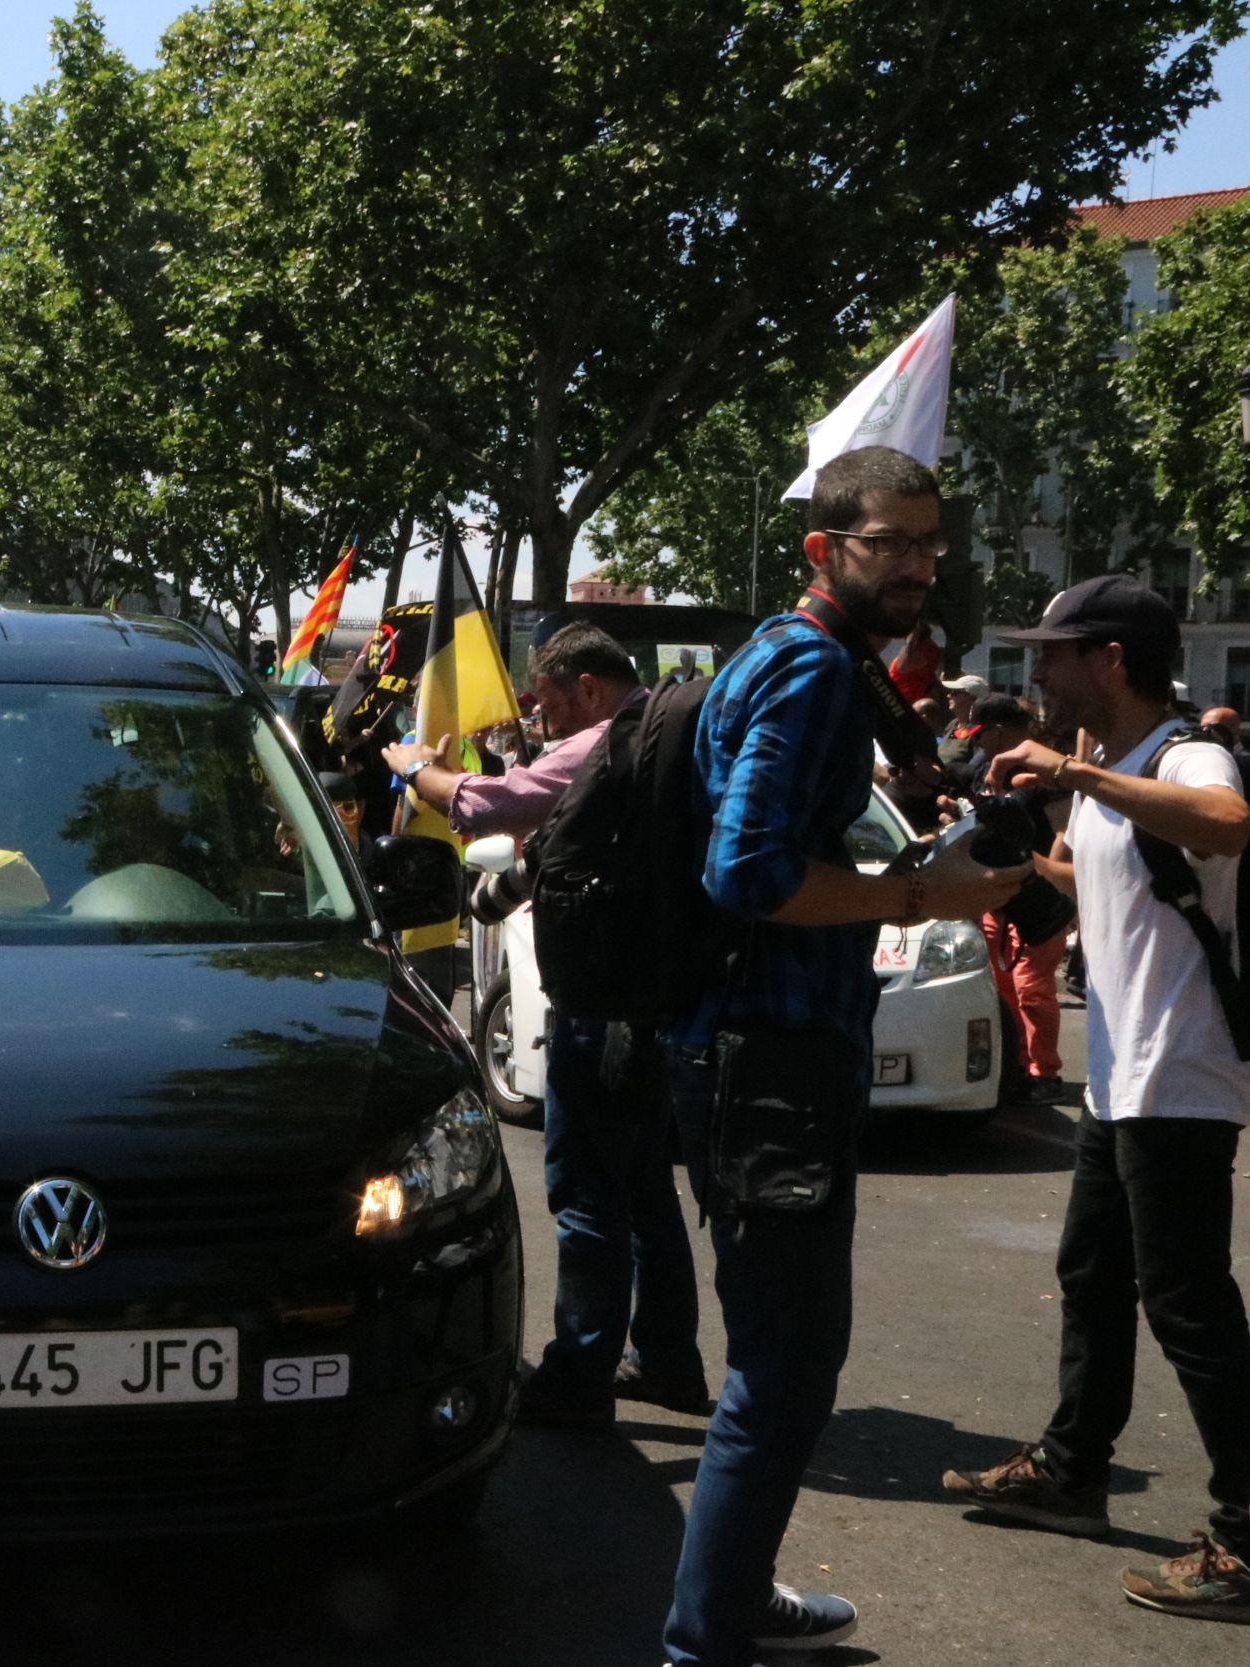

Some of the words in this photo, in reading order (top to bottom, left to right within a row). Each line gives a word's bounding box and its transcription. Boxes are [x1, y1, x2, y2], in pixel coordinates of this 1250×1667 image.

[862, 659, 906, 718] Canon
[121, 1339, 224, 1394] JFG
[272, 1359, 341, 1396] SP
